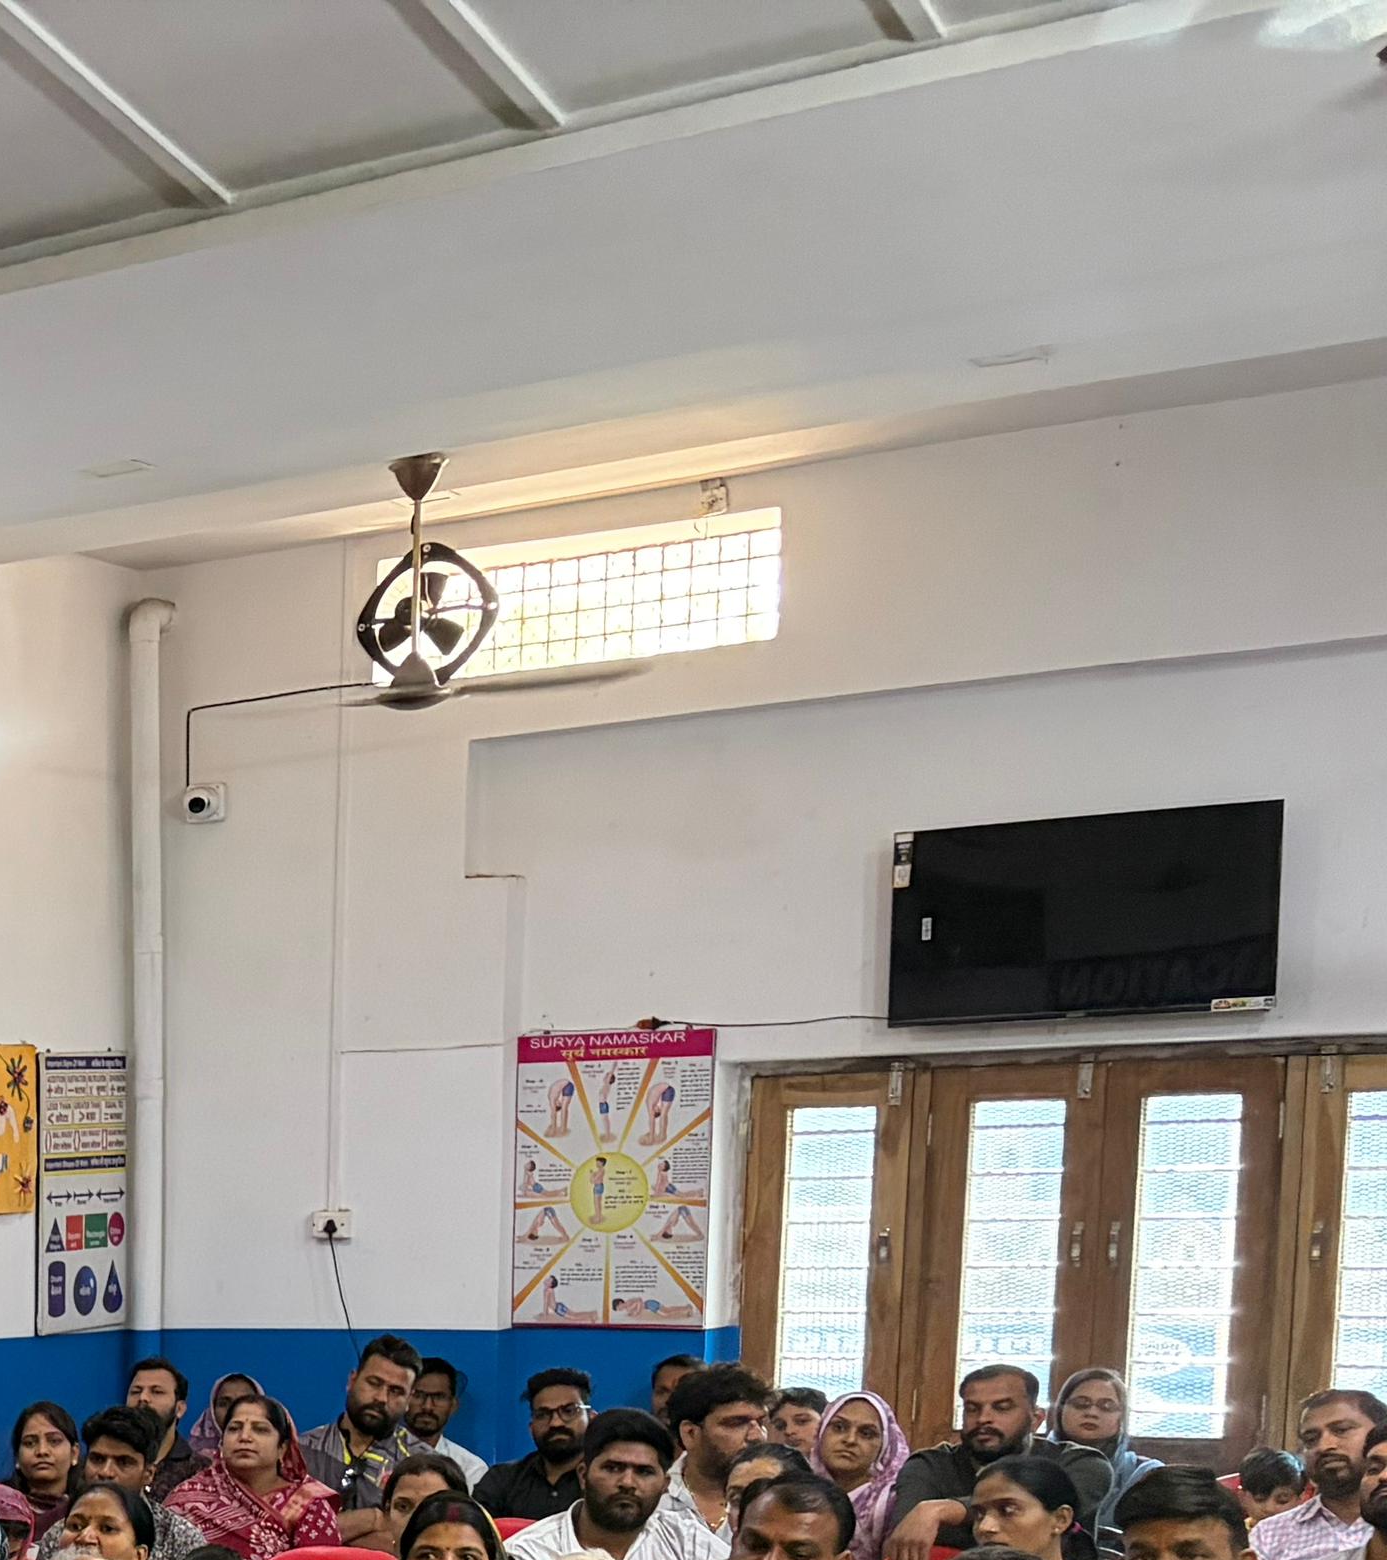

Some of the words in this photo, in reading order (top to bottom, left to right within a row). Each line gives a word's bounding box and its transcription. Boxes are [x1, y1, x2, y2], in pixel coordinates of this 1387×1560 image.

[530, 1036, 585, 1050] SURYA
[589, 1031, 686, 1046] NAMASKAR
[591, 1046, 649, 1057] नमस्कार
